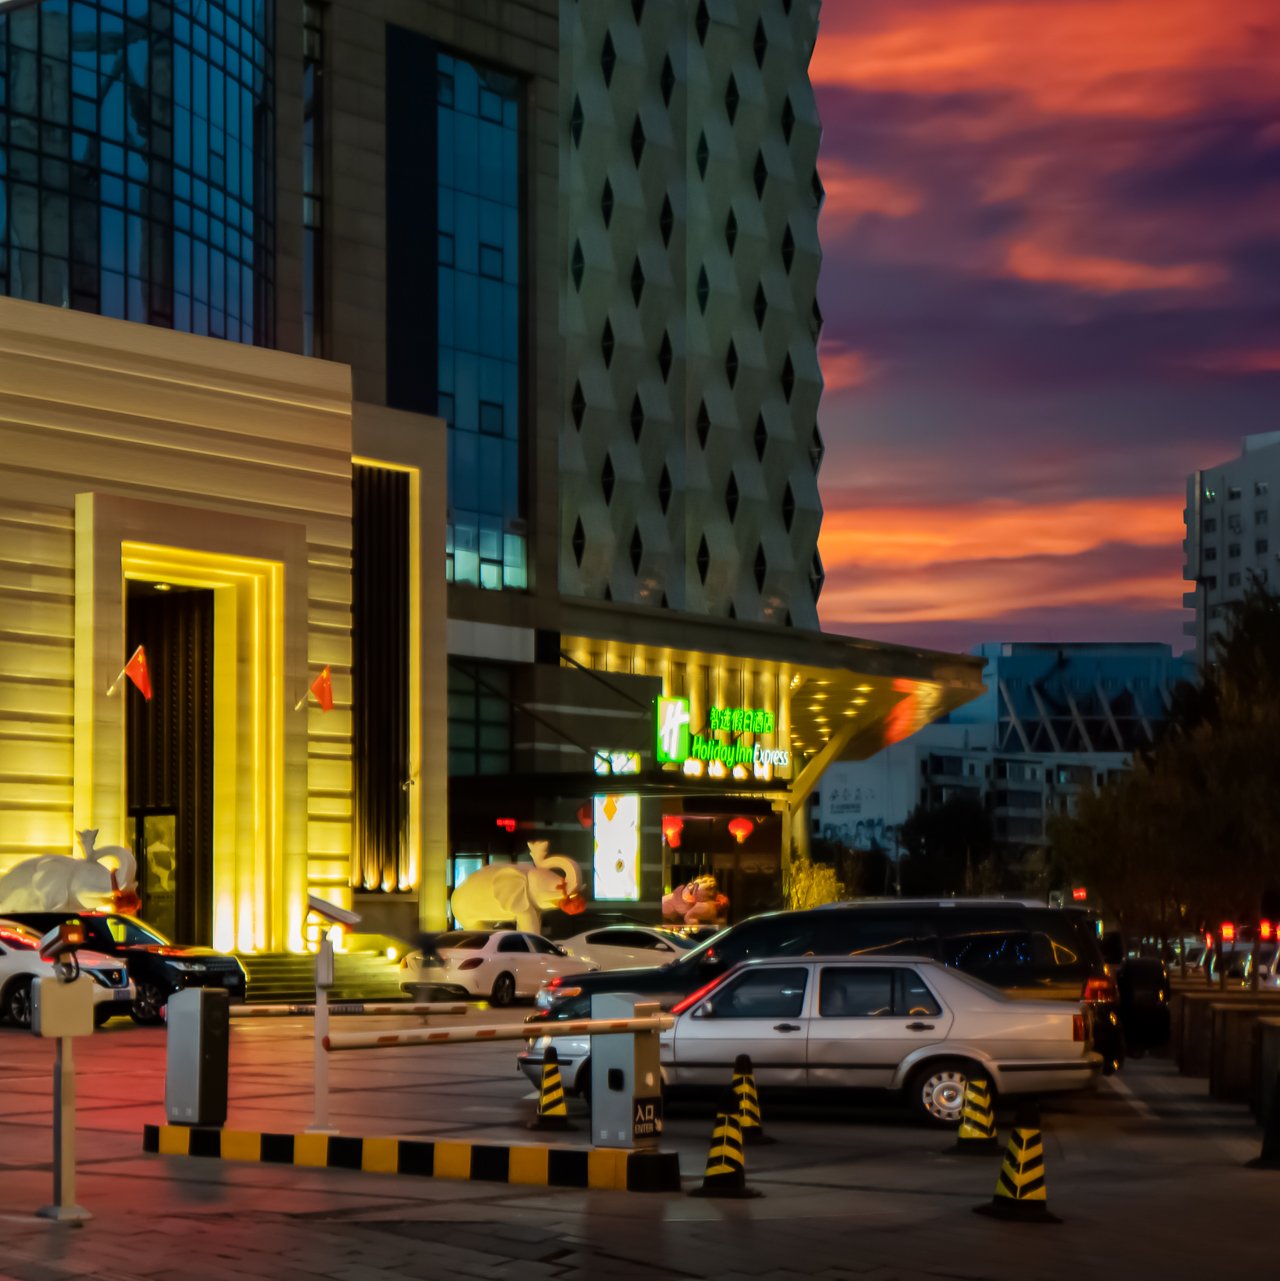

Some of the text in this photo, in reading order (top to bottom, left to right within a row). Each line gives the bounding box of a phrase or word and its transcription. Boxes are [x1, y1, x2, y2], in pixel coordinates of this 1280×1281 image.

[710, 705, 774, 734] 智选假日酒店
[692, 735, 789, 768] Holiday Inn Express
[635, 1104, 654, 1122] 入口
